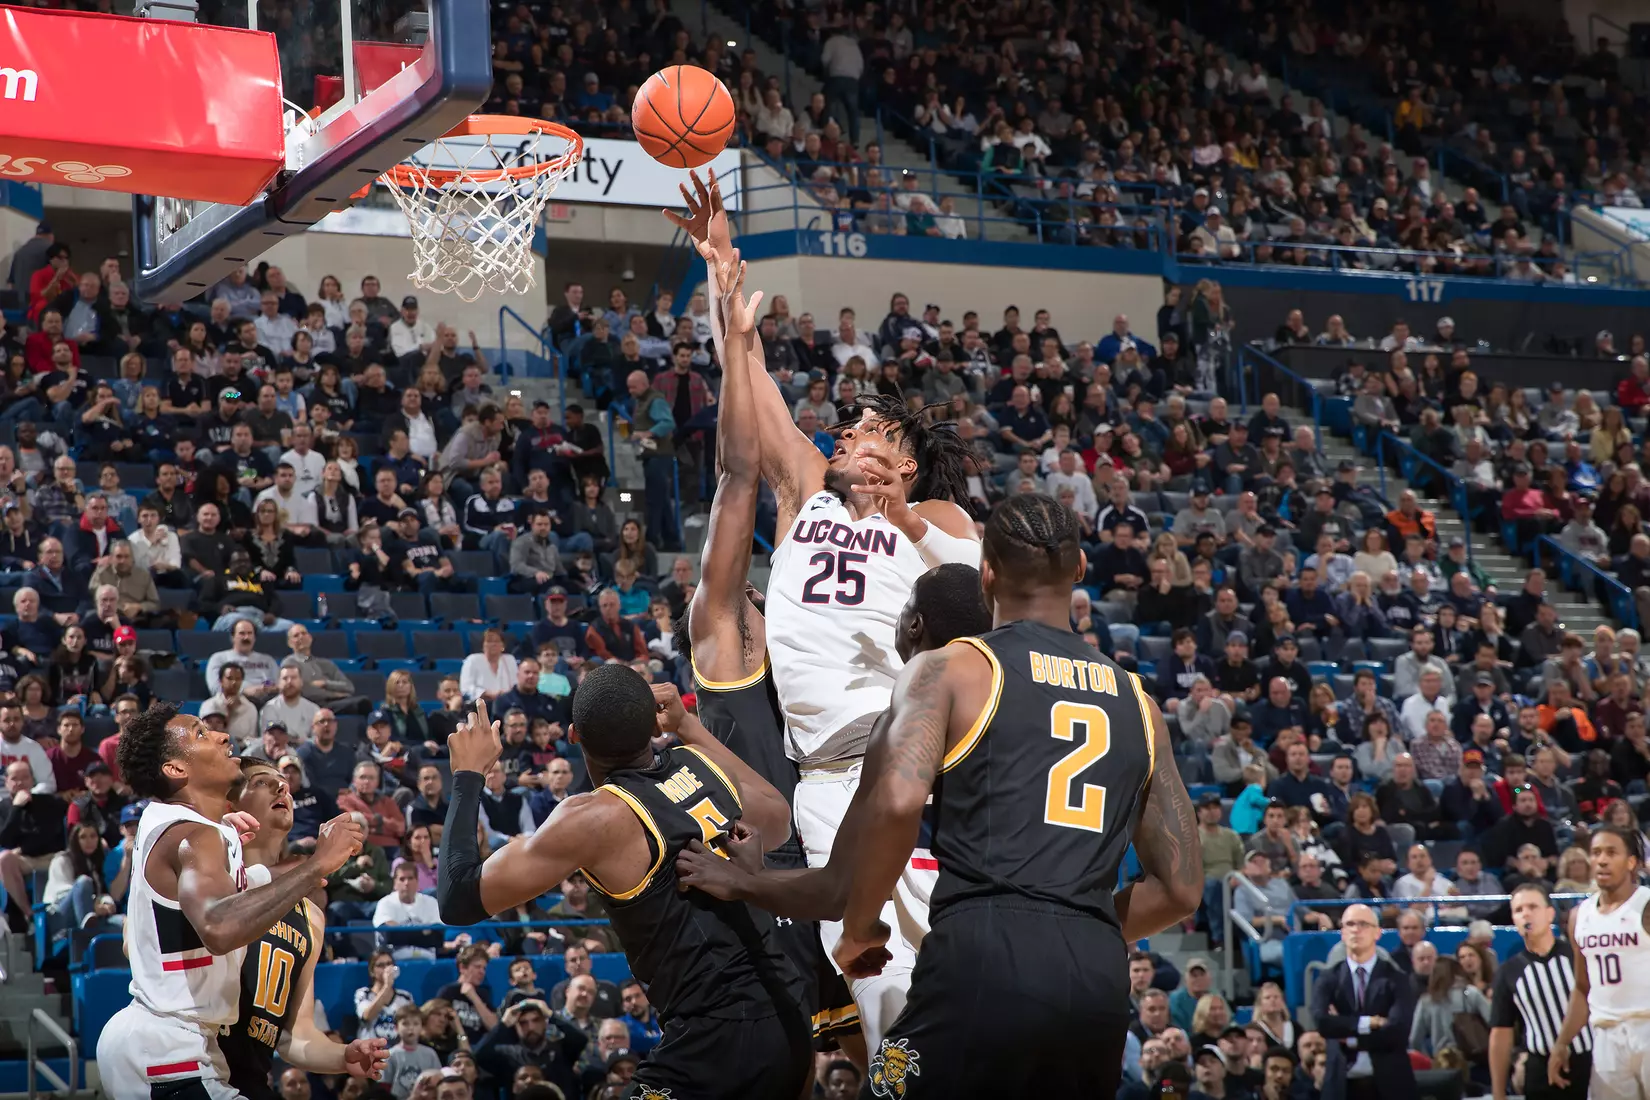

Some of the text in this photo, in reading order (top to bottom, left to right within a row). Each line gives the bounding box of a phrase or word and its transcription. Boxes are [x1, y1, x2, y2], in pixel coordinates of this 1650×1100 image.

[819, 231, 867, 258] 116
[1405, 280, 1445, 302] 117
[792, 519, 898, 557] UCONN
[801, 550, 868, 606] 25
[1029, 650, 1119, 697] BURTON
[1044, 700, 1111, 833] 2
[685, 796, 731, 861] 5
[1578, 932, 1639, 950] UCONN
[253, 941, 296, 1018] 10
[1594, 953, 1622, 986] 10
